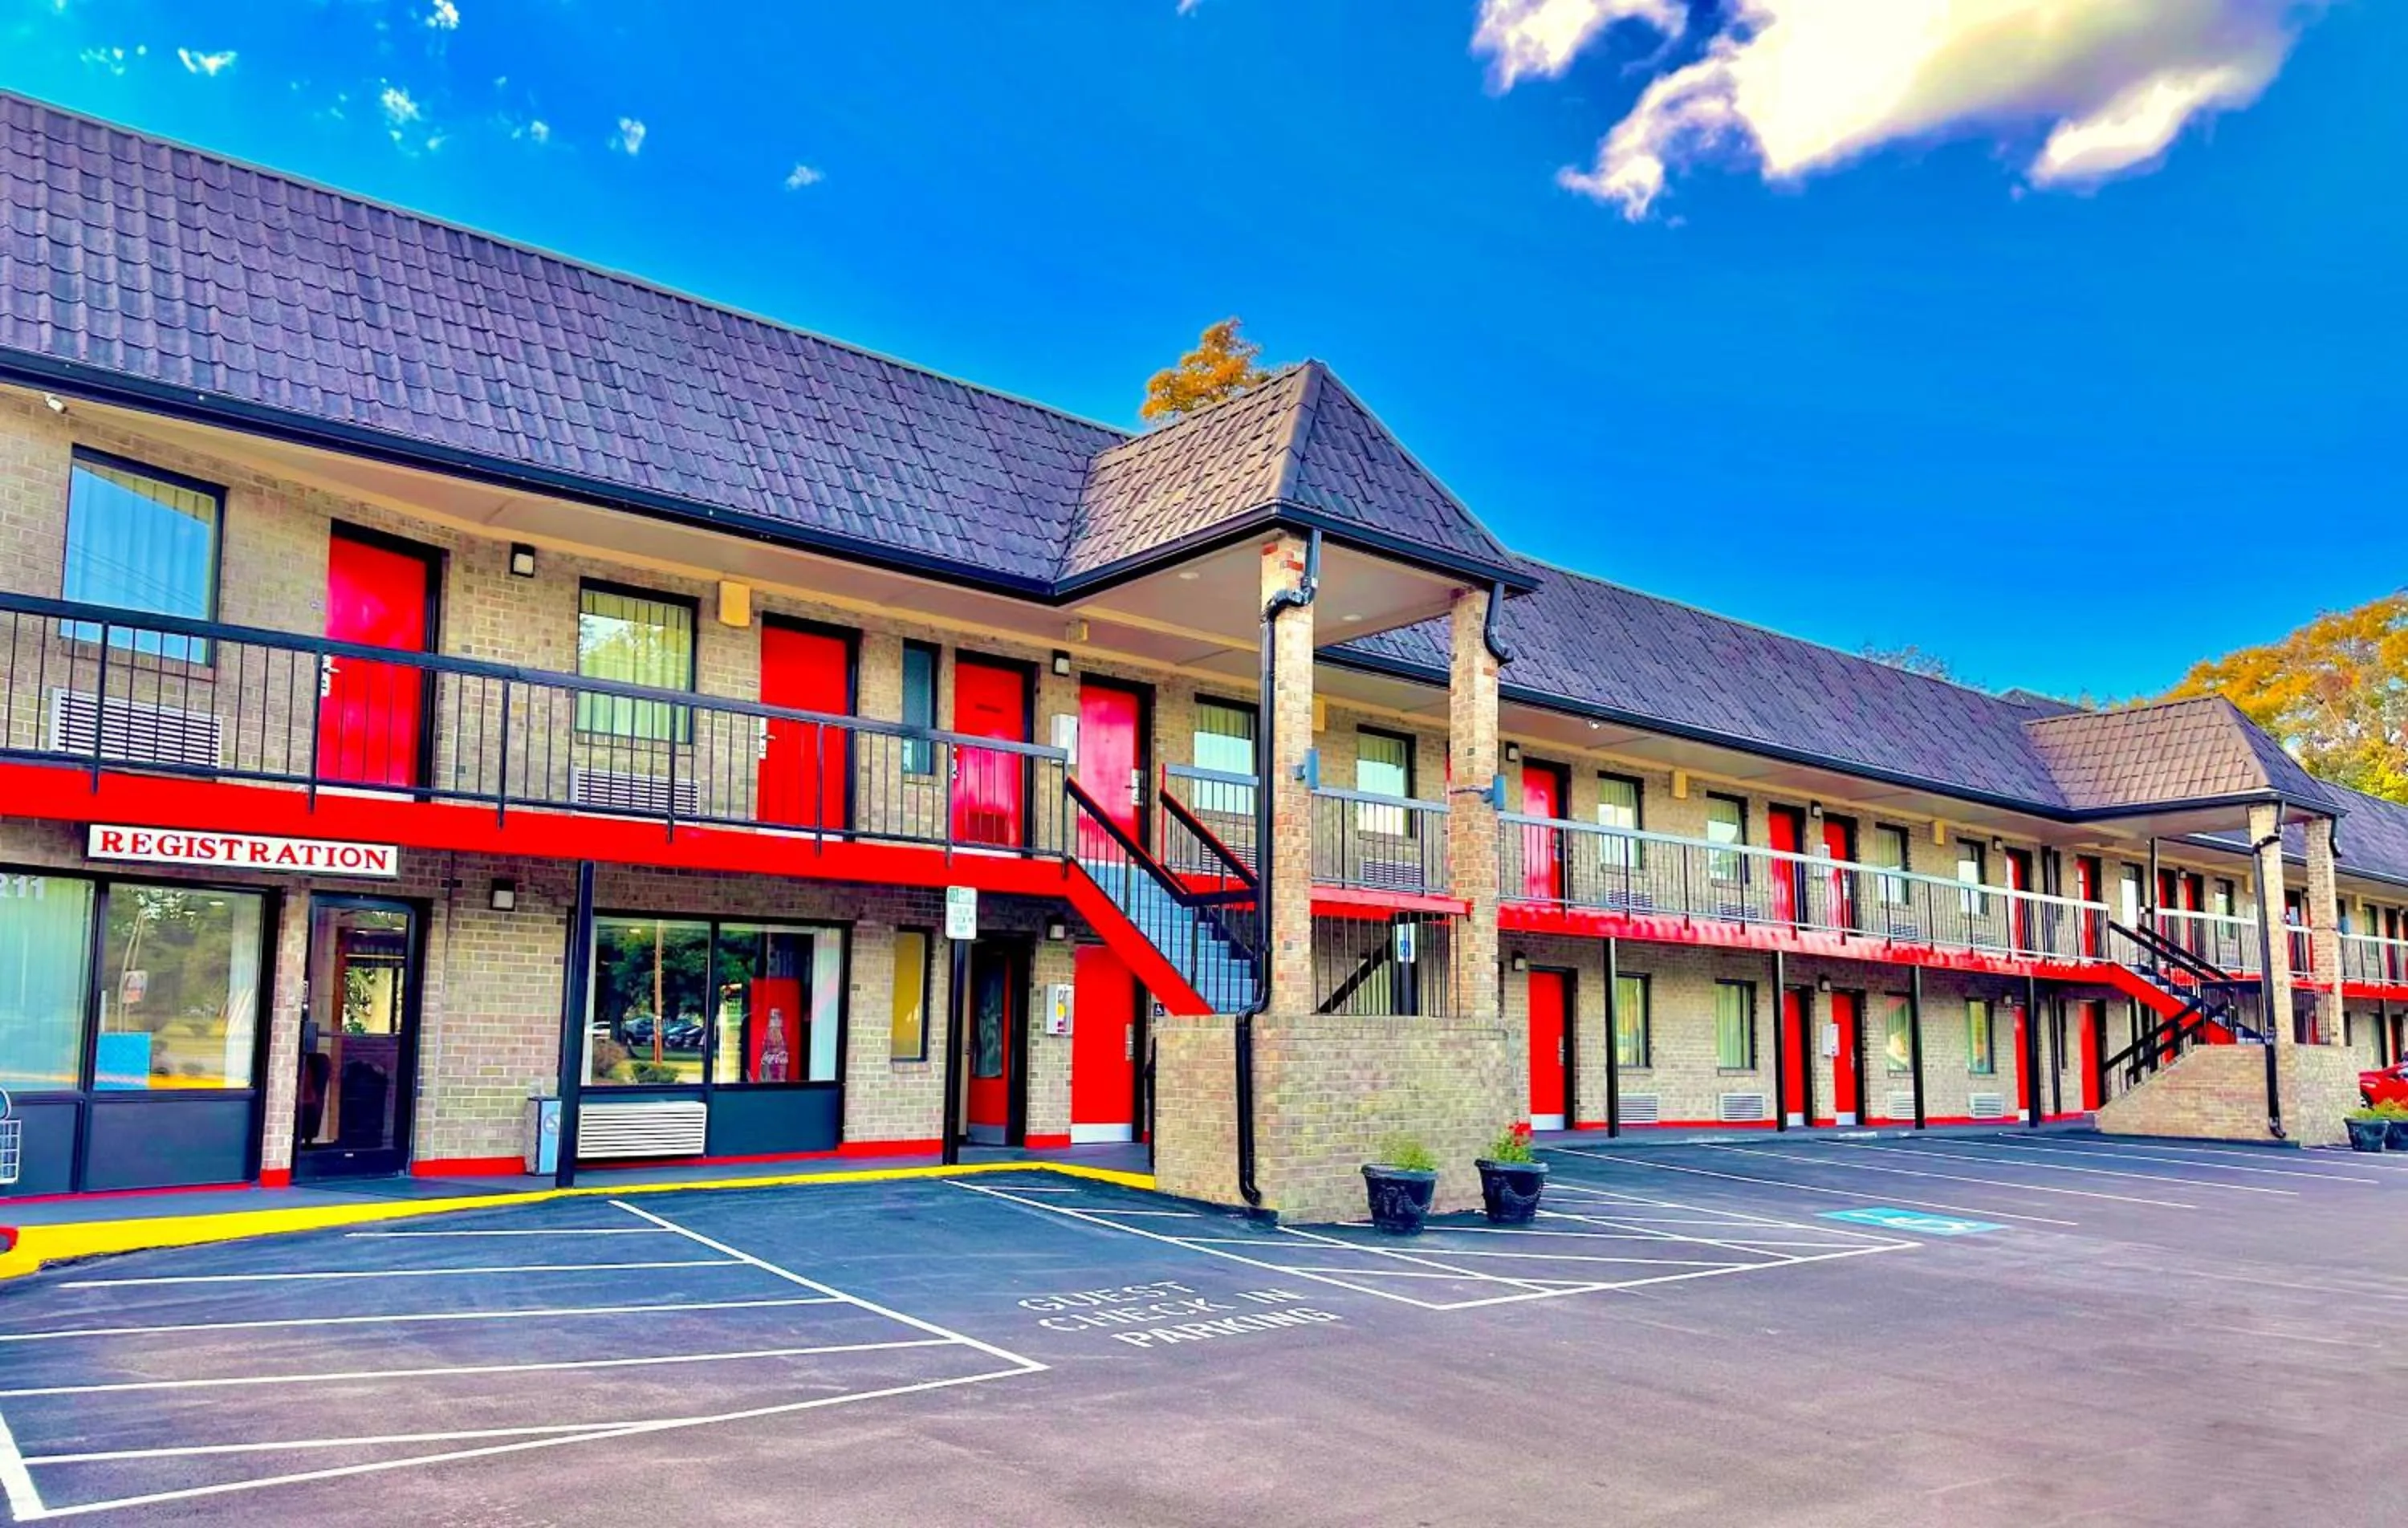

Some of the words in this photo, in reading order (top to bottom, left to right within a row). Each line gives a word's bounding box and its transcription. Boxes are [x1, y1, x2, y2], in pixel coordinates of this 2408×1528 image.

[100, 831, 388, 870] REGISTRATION
[1018, 1282, 1194, 1311] GUEST
[1039, 1298, 1237, 1331] CHECK
[1235, 1288, 1306, 1303] IN
[1111, 1308, 1343, 1347] PARKING
